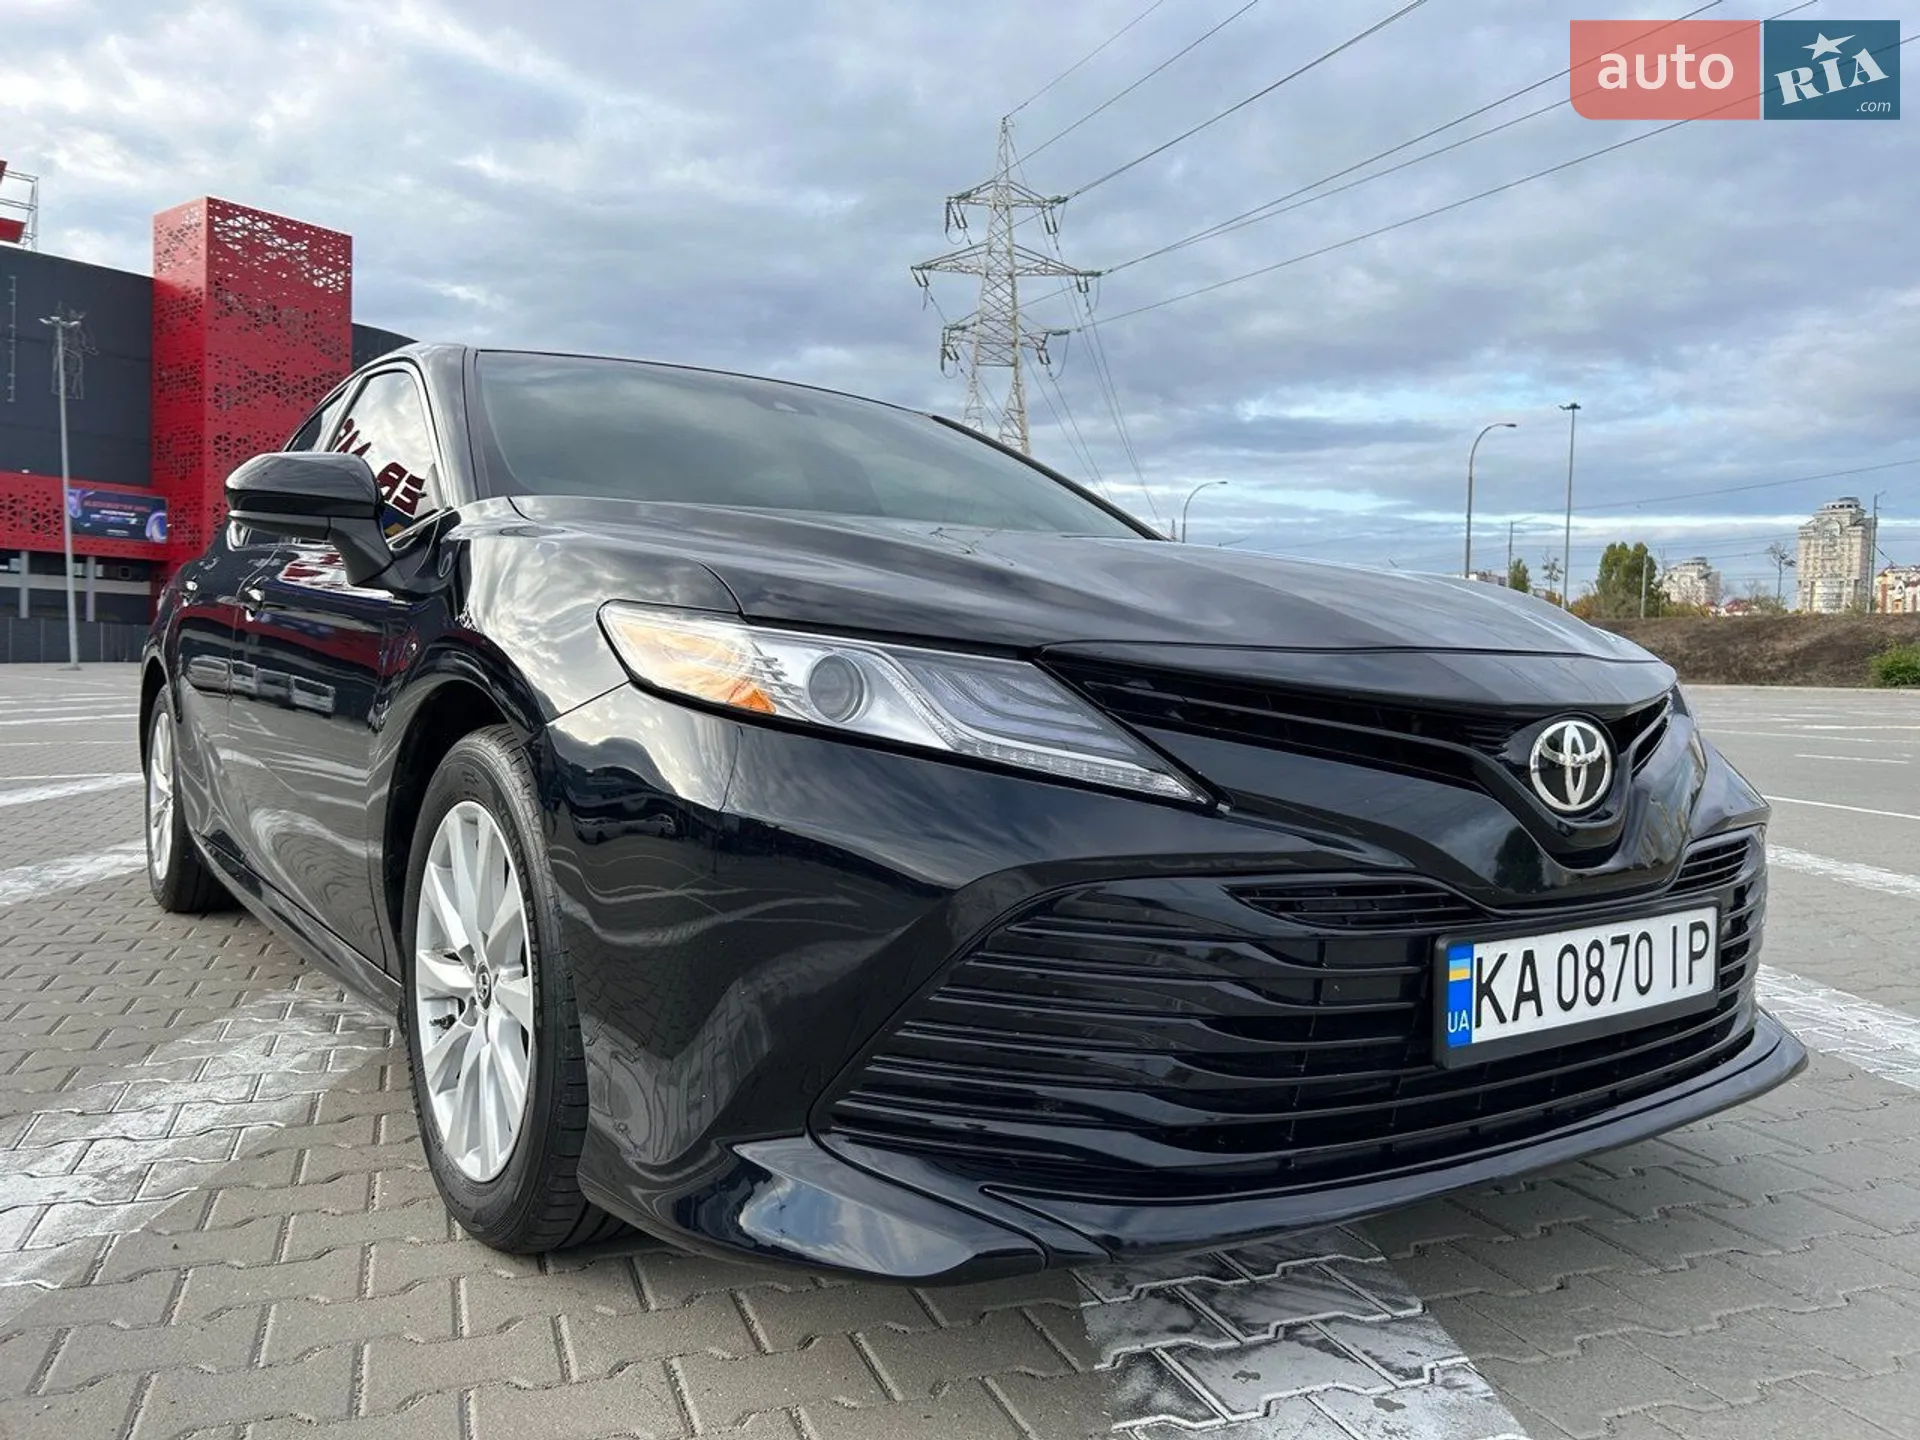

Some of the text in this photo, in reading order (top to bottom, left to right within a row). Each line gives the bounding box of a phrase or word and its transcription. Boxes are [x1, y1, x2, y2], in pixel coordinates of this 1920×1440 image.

[1475, 920, 1710, 1028] KA 0870 IP
[1447, 1010, 1469, 1033] UA
